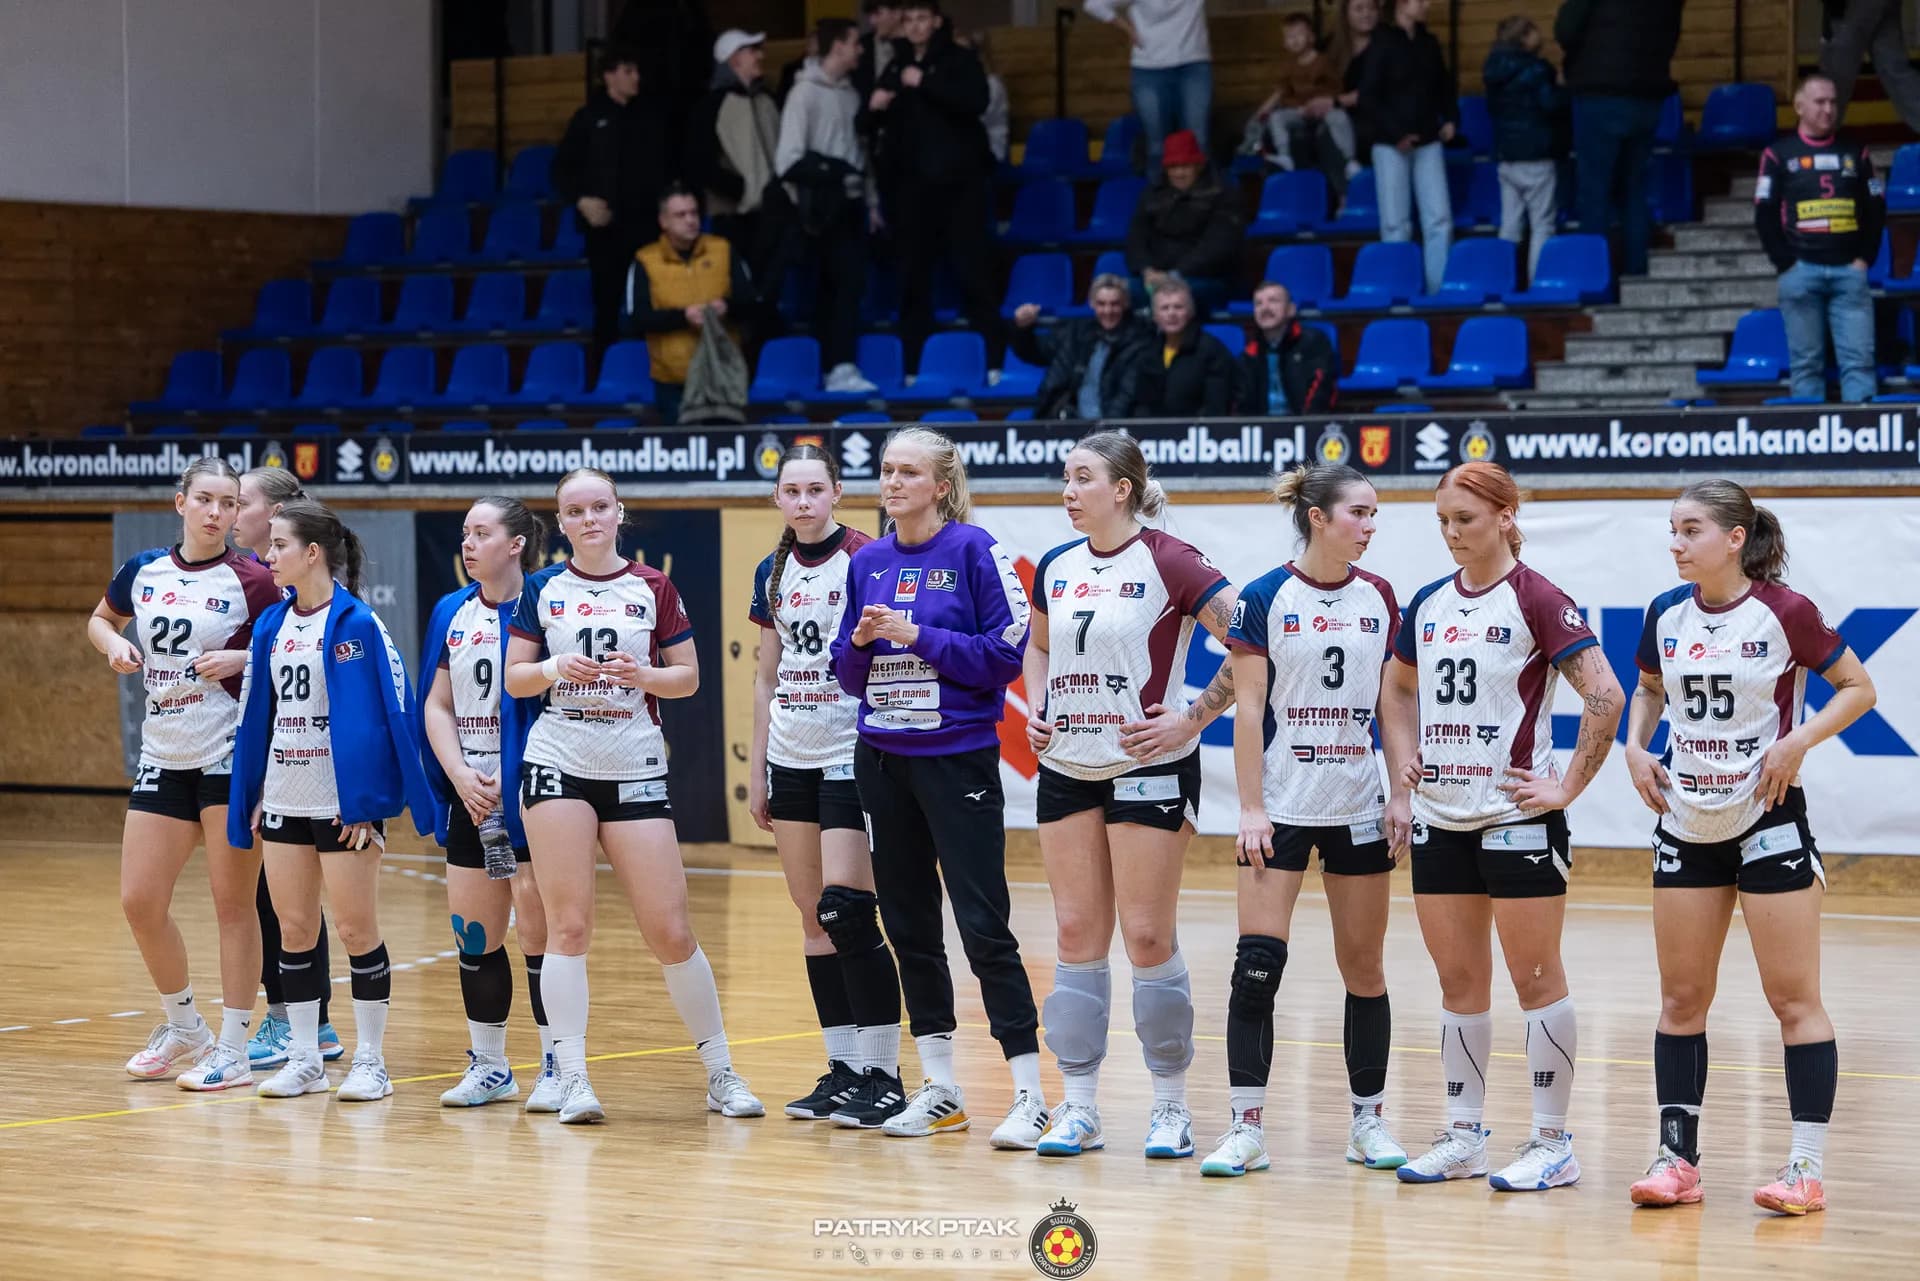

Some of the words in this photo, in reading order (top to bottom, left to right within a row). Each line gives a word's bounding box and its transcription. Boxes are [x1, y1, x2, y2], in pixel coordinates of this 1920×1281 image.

[1819, 174, 1835, 198] 5
[1506, 412, 1920, 463] www.koronahandball.
[409, 434, 745, 480] www.koronahandball.pl
[150, 616, 193, 657] 22
[790, 620, 823, 656] 18
[1072, 610, 1095, 655] 7
[576, 627, 618, 663] 13
[871, 661, 914, 672] WESTMAR
[1321, 646, 1345, 690] 3
[280, 664, 310, 702] 28
[474, 658, 492, 700] 9
[1435, 657, 1477, 706] 33
[790, 691, 802, 703] net
[804, 691, 840, 703] marine
[902, 687, 931, 698] marine
[1681, 674, 1735, 721] 55
[790, 704, 818, 712] group
[889, 699, 913, 707] group
[1070, 712, 1085, 724] net
[1087, 712, 1125, 725] marine
[1287, 707, 1348, 719] WESTMAR
[584, 717, 615, 725] group
[1070, 727, 1102, 735] group
[297, 747, 330, 758] marine
[1316, 744, 1333, 755] net
[1334, 744, 1366, 756] marine
[285, 759, 310, 767] group
[1316, 757, 1346, 765] group
[1440, 763, 1454, 775] net
[1456, 763, 1493, 777] marine
[529, 765, 563, 796] 13
[1440, 778, 1471, 787] group
[1697, 773, 1713, 785] net
[1699, 787, 1733, 796] group
